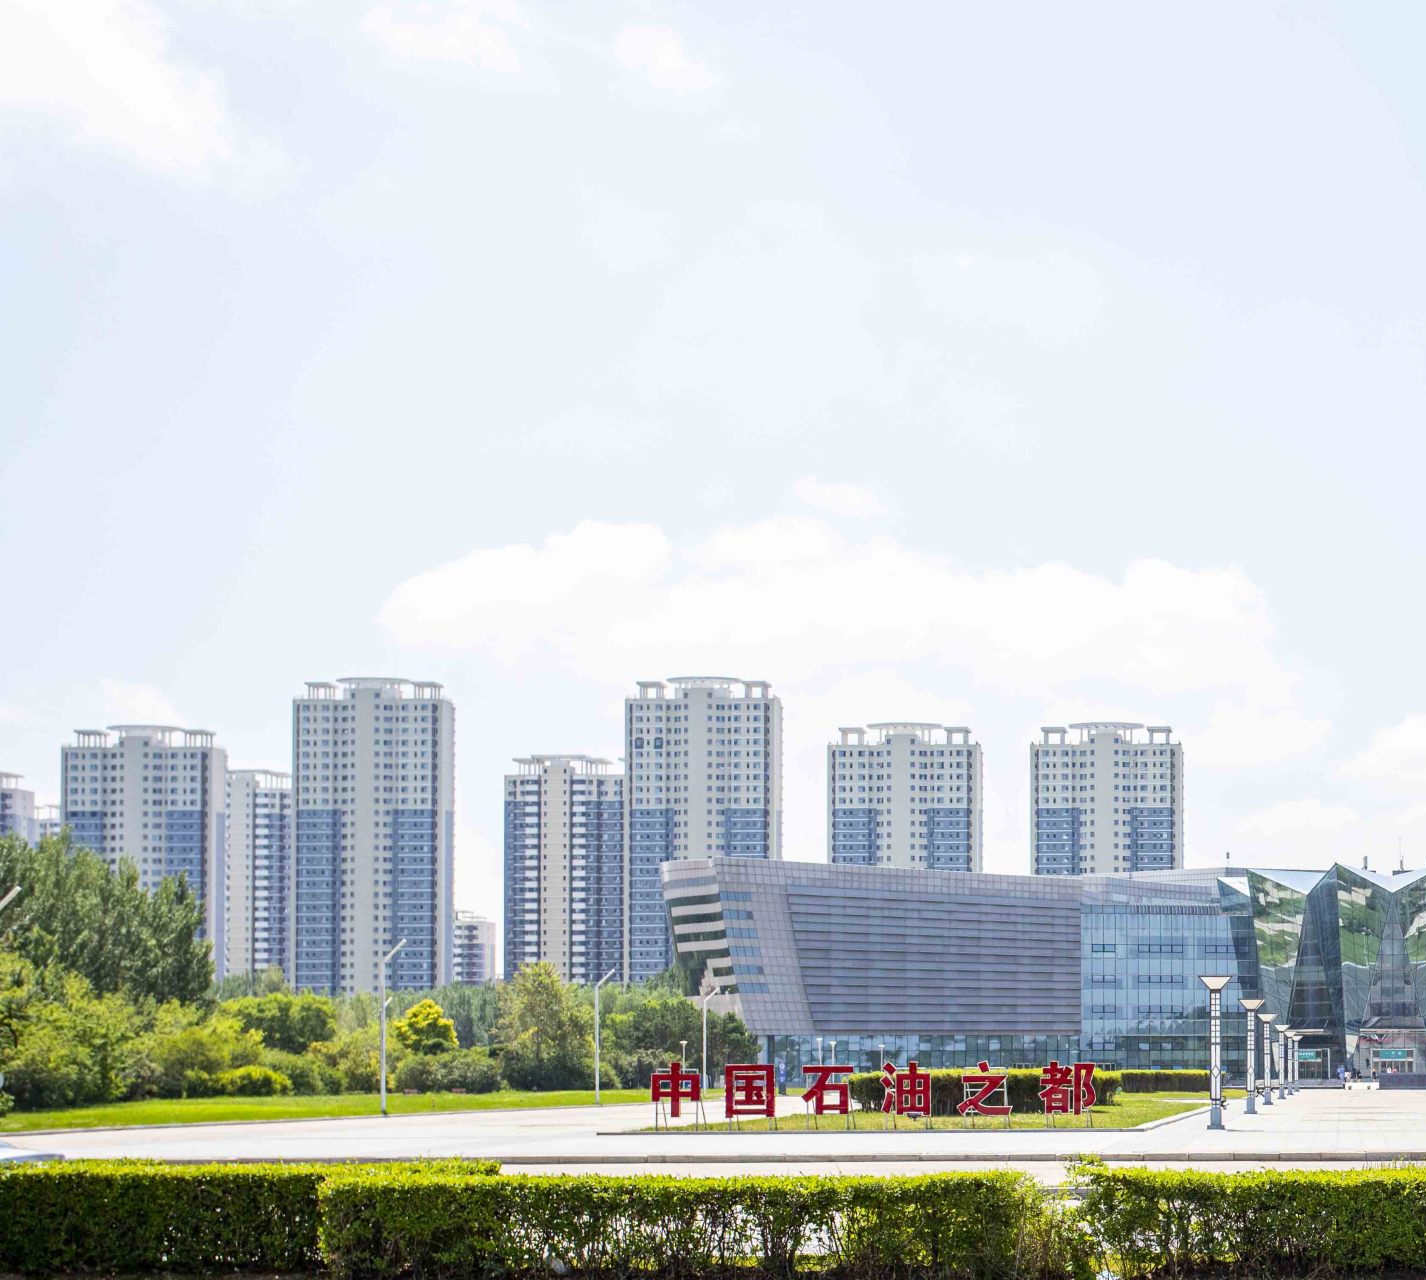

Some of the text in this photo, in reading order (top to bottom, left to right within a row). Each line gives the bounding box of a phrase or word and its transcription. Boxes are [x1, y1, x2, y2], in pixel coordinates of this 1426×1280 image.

[651, 1060, 1096, 1118] 中国石油之都
